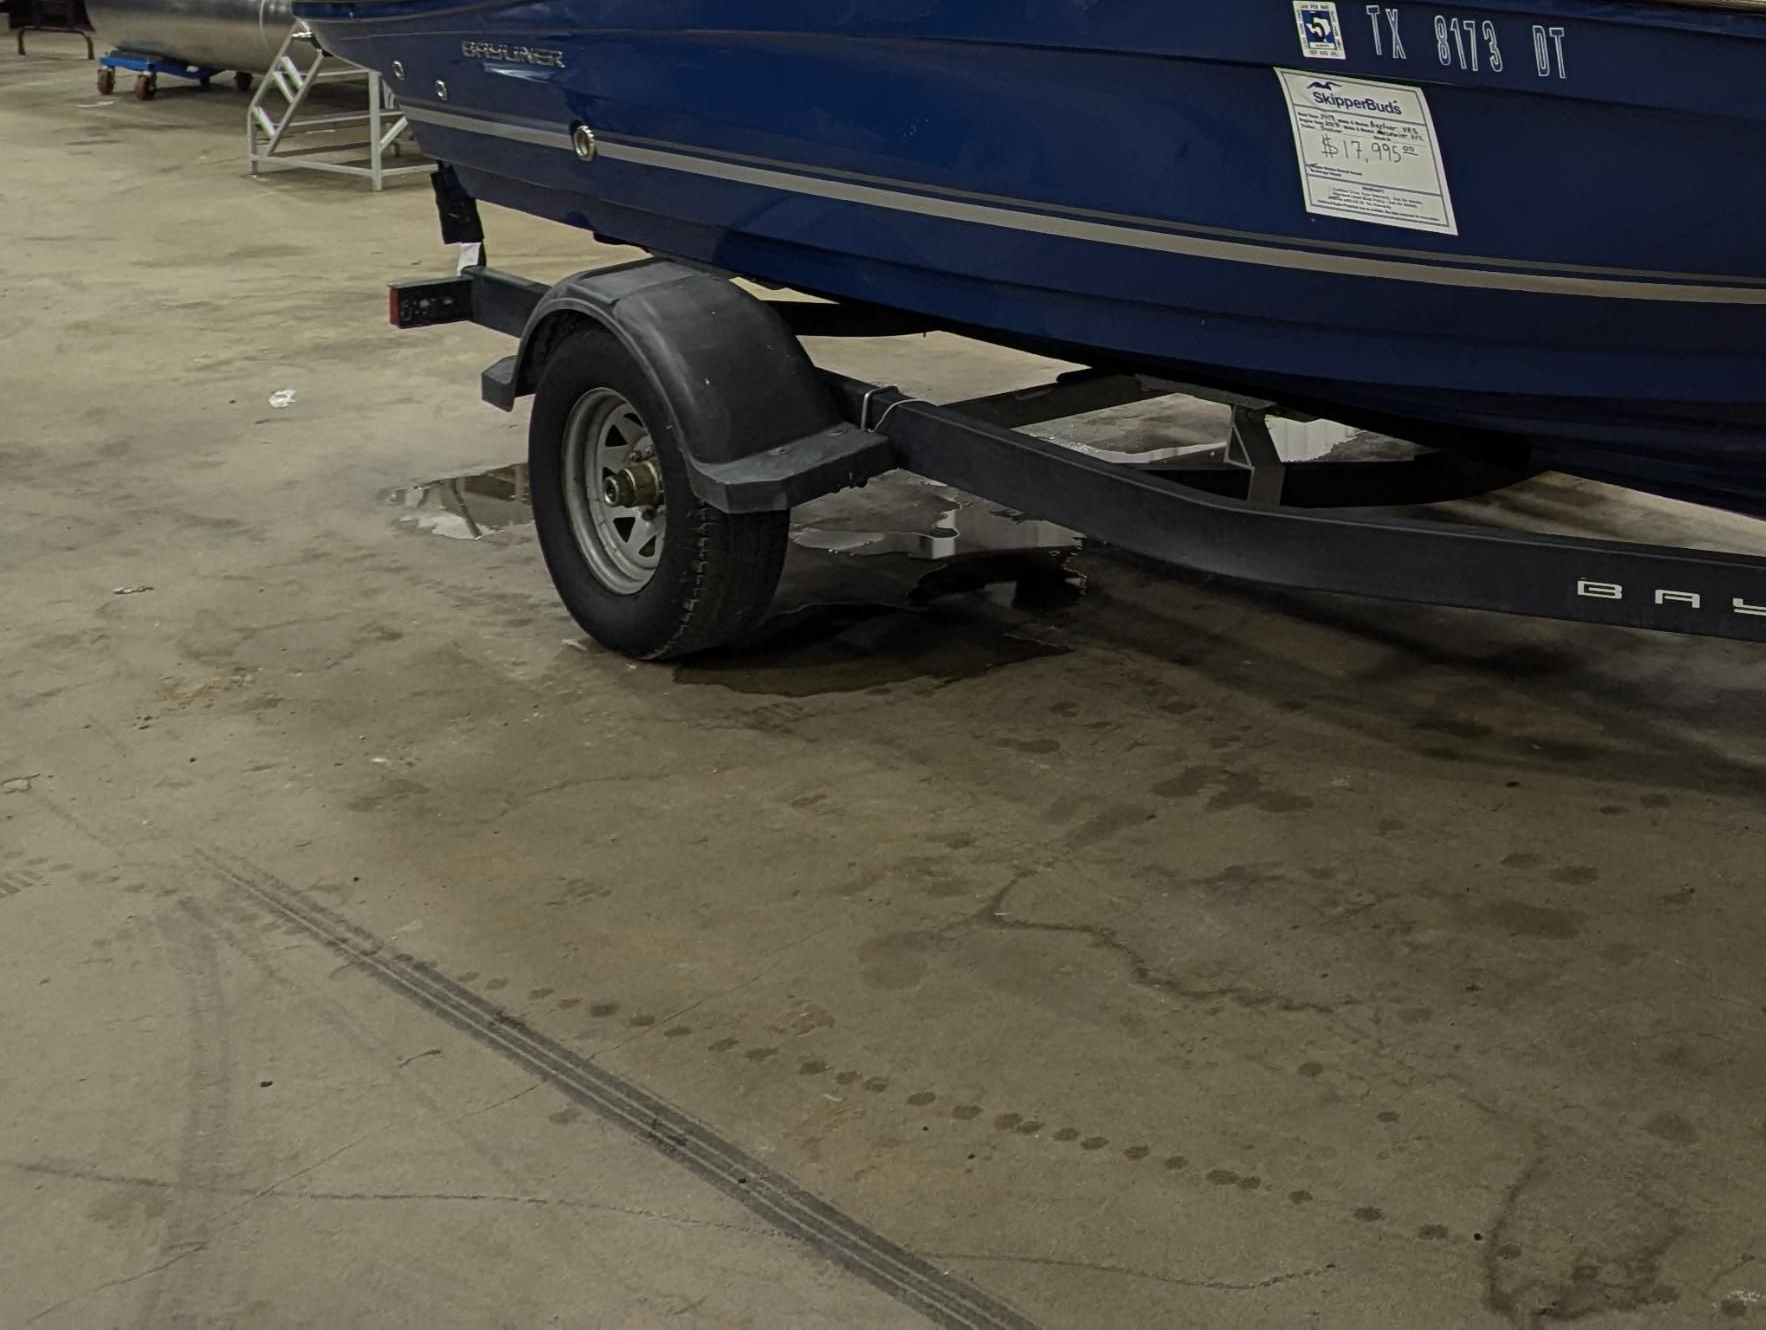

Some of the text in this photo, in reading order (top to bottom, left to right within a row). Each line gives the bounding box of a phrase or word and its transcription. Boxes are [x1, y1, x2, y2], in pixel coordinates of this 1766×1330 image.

[462, 41, 566, 69] BAYLINER
[1365, 4, 1407, 60] TX
[1434, 15, 1503, 73] 8173
[1532, 24, 1567, 79] DT
